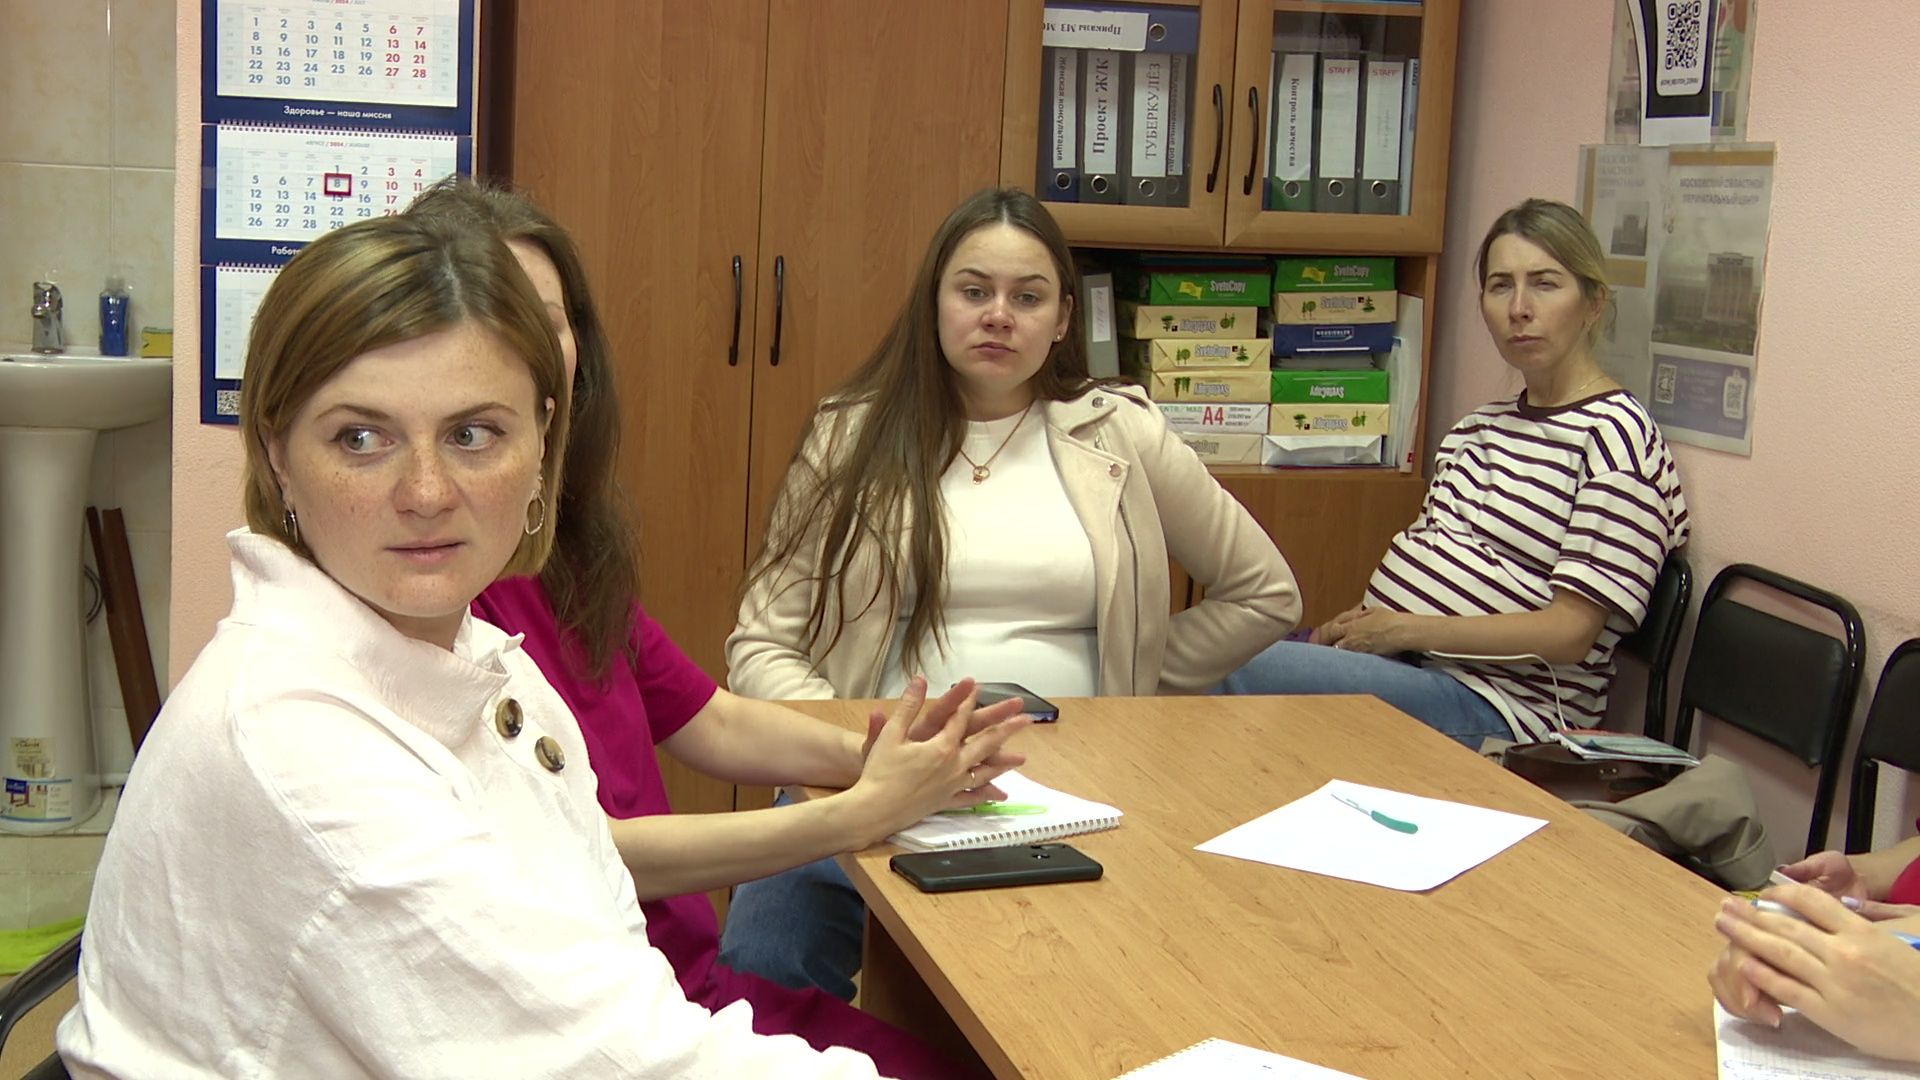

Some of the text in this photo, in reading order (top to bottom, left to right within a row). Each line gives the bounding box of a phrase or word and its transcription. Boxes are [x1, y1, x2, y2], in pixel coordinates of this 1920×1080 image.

[253, 17, 424, 36] 1 2 3 4 5 6 7
[1078, 23, 1122, 35] Приказы
[252, 32, 427, 50] 8 9 10 11 12 13 14
[250, 46, 425, 65] 15 16 17 18 19 20 21
[248, 60, 427, 79] 22 23 24 25 26 27 28
[248, 74, 264, 84] 29
[275, 76, 291, 86] 30
[303, 77, 316, 87] 31
[283, 105, 325, 116] Здоровье
[337, 110, 361, 118] наша
[362, 111, 392, 119] миссия
[1056, 57, 1067, 161] Женская консультация
[1092, 57, 1109, 154] Проект Ж/К
[1145, 63, 1161, 160] ТУБЕРКУЛЁЗ
[1288, 78, 1299, 167] Контроль качества
[360, 166, 368, 176] 2
[387, 168, 395, 177] 3
[414, 169, 422, 178] 4
[251, 175, 422, 192] 5 6 7 8 9 10 11
[250, 189, 262, 199] 12
[276, 190, 290, 200] 13
[304, 192, 317, 201] 14
[358, 194, 371, 204] 16
[385, 195, 398, 205] 17
[250, 203, 263, 213] 19
[275, 204, 291, 214] 20
[303, 206, 315, 215] 21
[330, 207, 344, 217] 22
[356, 208, 371, 218] 23
[247, 217, 263, 227] 26
[275, 218, 290, 228] 27
[302, 219, 317, 229] 28
[1333, 265, 1369, 278] SvetoCopy
[1210, 280, 1246, 294] SvetoCopy
[1320, 296, 1356, 310] SvetoCopy
[1195, 344, 1231, 359] SvetoCopy
[1310, 385, 1344, 399] SvetoCopy
[1202, 406, 1225, 426] A4
[1312, 416, 1348, 432] SvetoCopy
